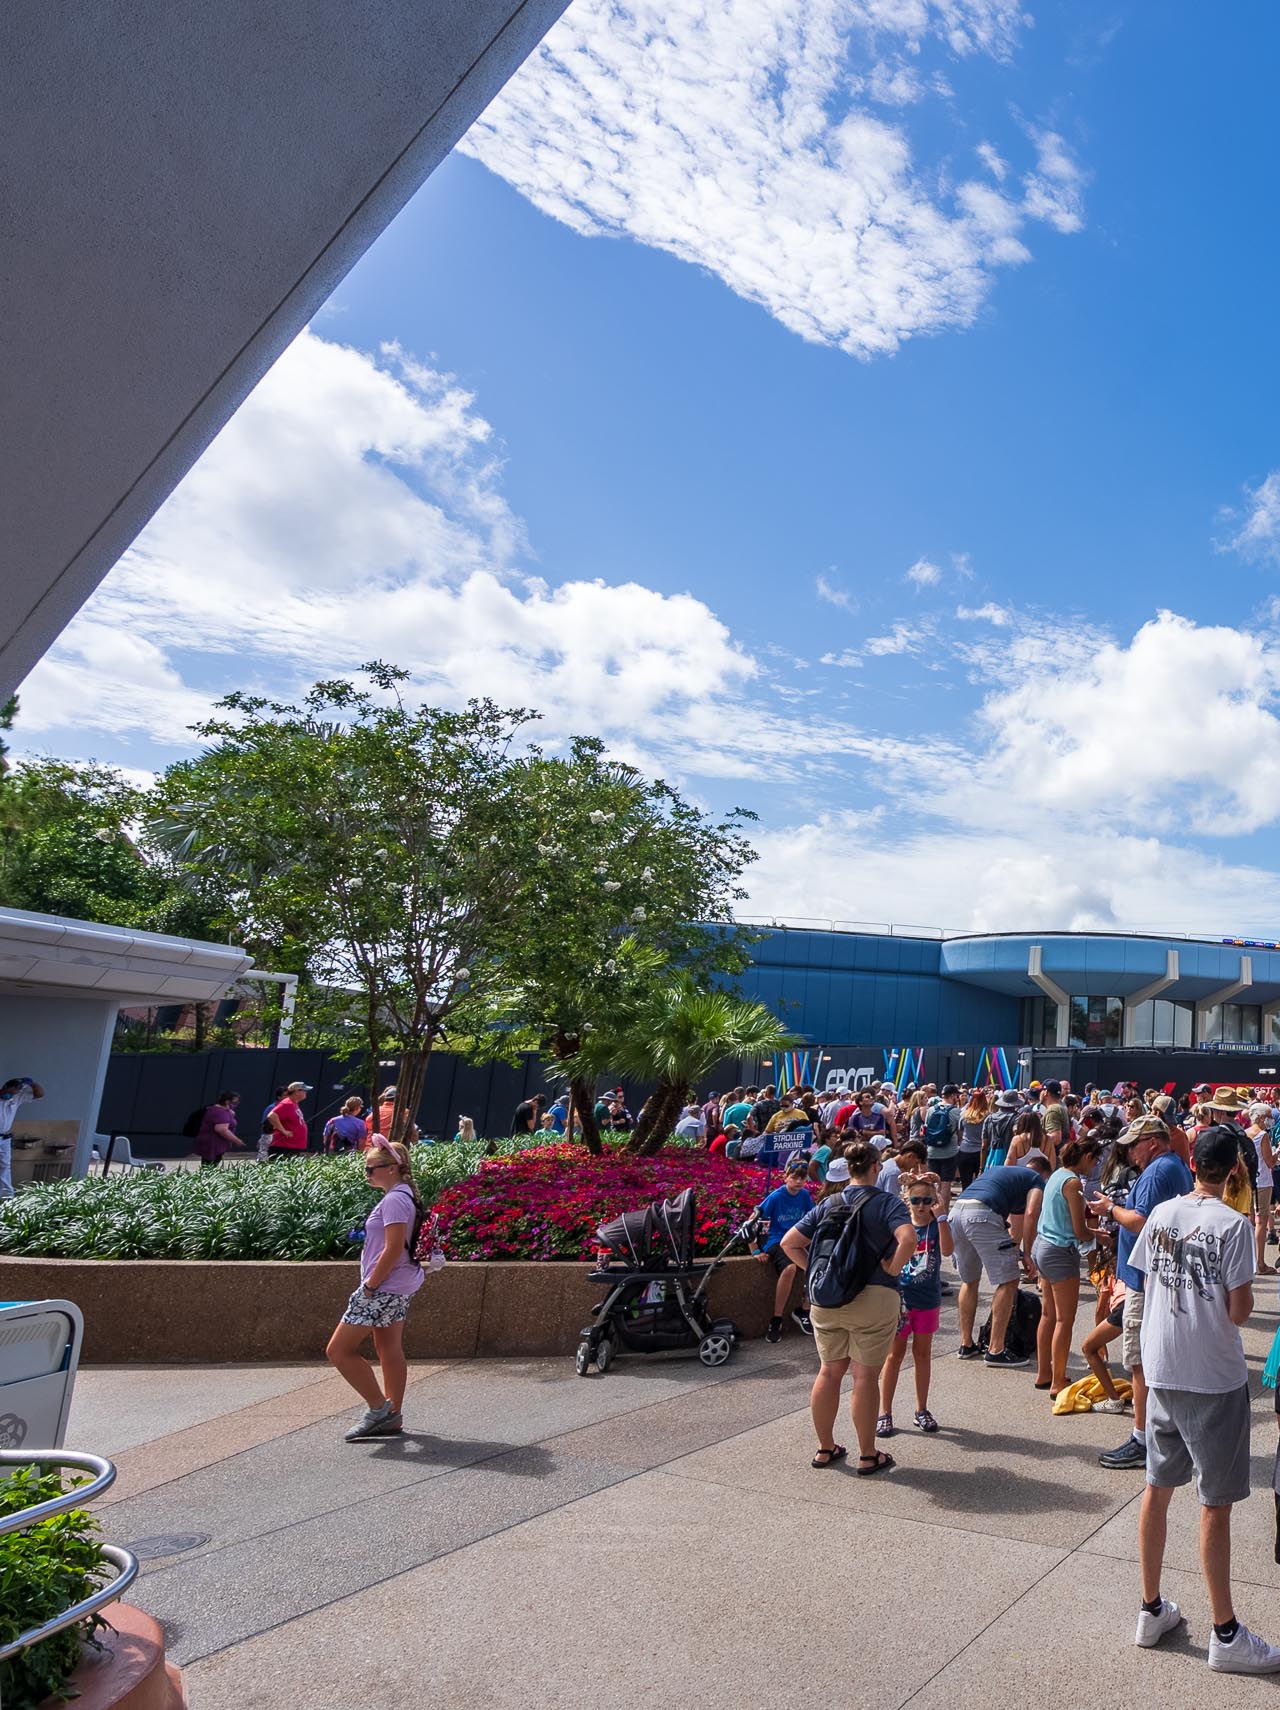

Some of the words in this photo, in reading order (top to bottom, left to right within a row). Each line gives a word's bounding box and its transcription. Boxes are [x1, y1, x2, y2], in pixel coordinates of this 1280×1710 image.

[826, 1067, 875, 1091] EPCOT
[773, 1133, 806, 1143] STROLLER
[773, 1141, 804, 1150] PARKING
